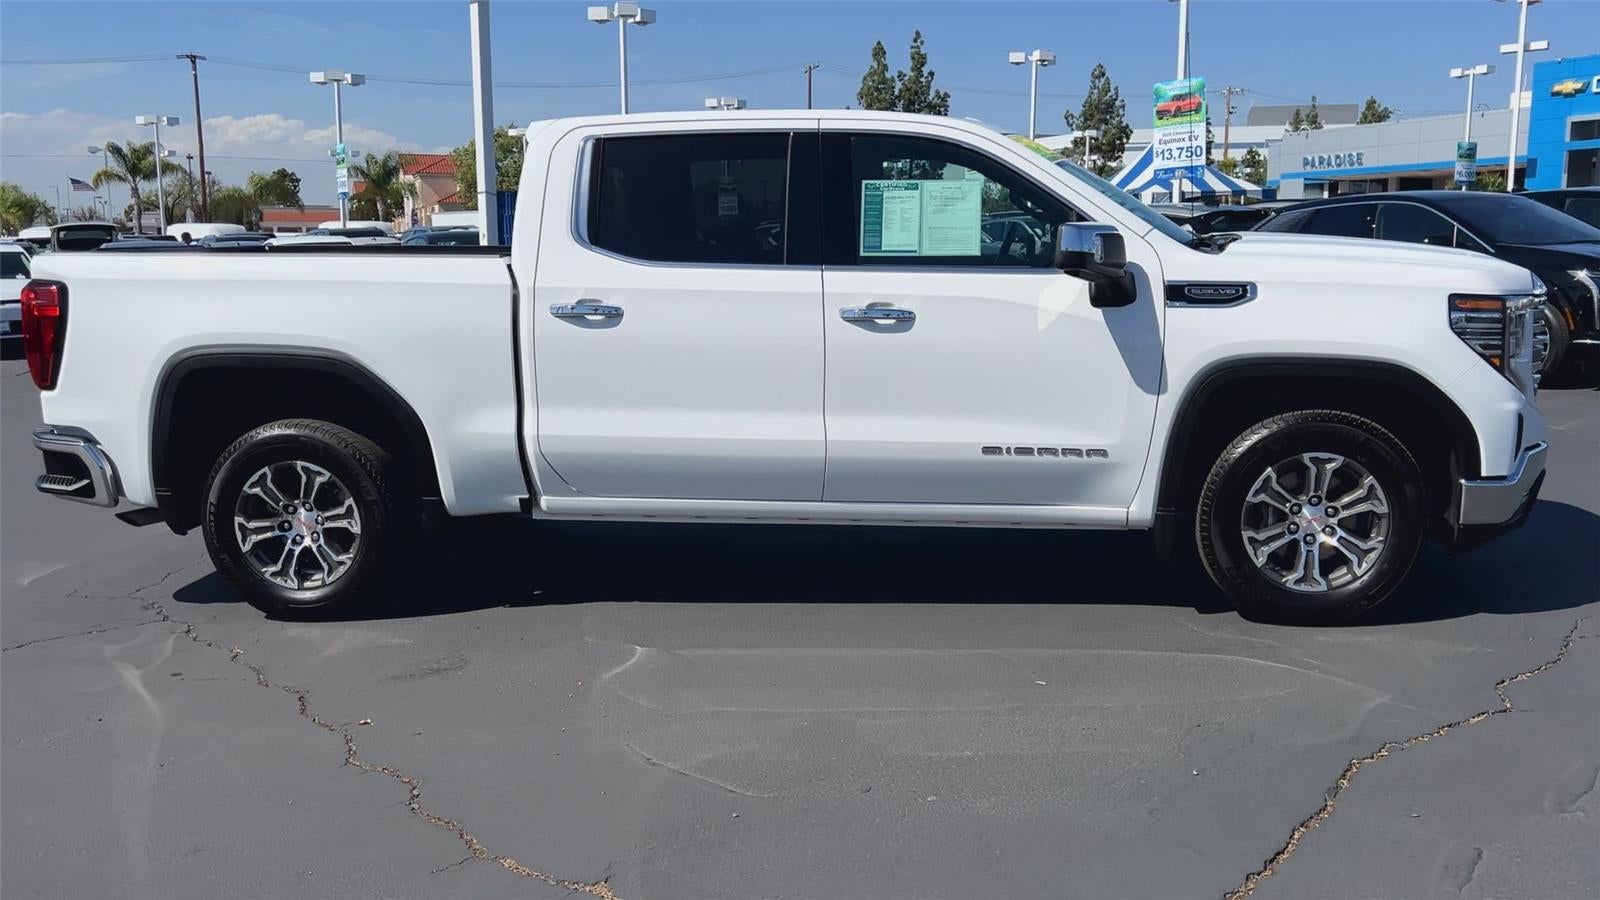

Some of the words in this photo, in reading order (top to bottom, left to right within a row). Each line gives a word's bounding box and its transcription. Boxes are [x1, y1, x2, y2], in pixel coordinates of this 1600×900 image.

[1158, 136, 1186, 146] Equinox
[1187, 134, 1199, 142] EV
[1155, 145, 1203, 161] $13,750
[1303, 152, 1364, 169] PARADISE
[981, 446, 1109, 459] SIERRA
